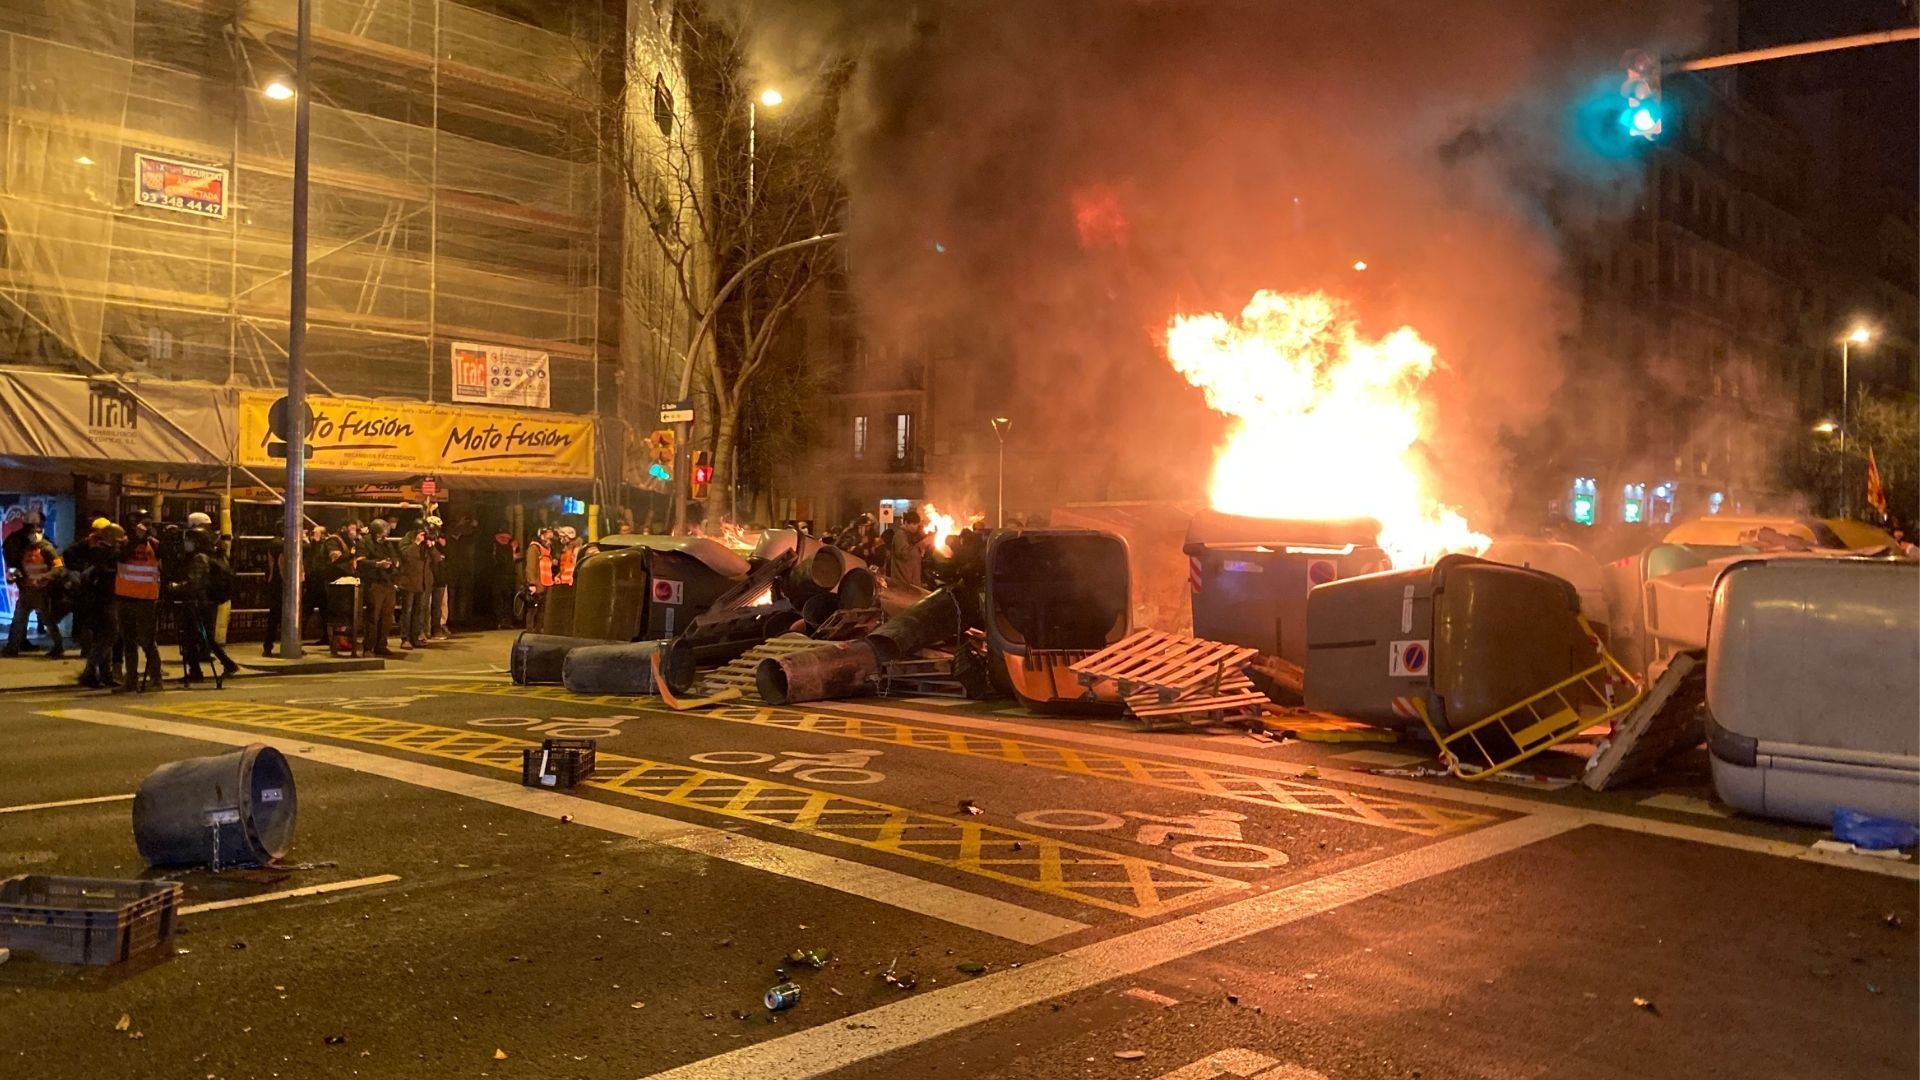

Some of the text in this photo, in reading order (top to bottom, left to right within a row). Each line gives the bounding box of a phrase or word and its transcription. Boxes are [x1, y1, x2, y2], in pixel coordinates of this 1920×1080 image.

[141, 191, 221, 214] 93 348 44 47
[455, 356, 485, 386] Trac
[441, 423, 503, 457] Moto
